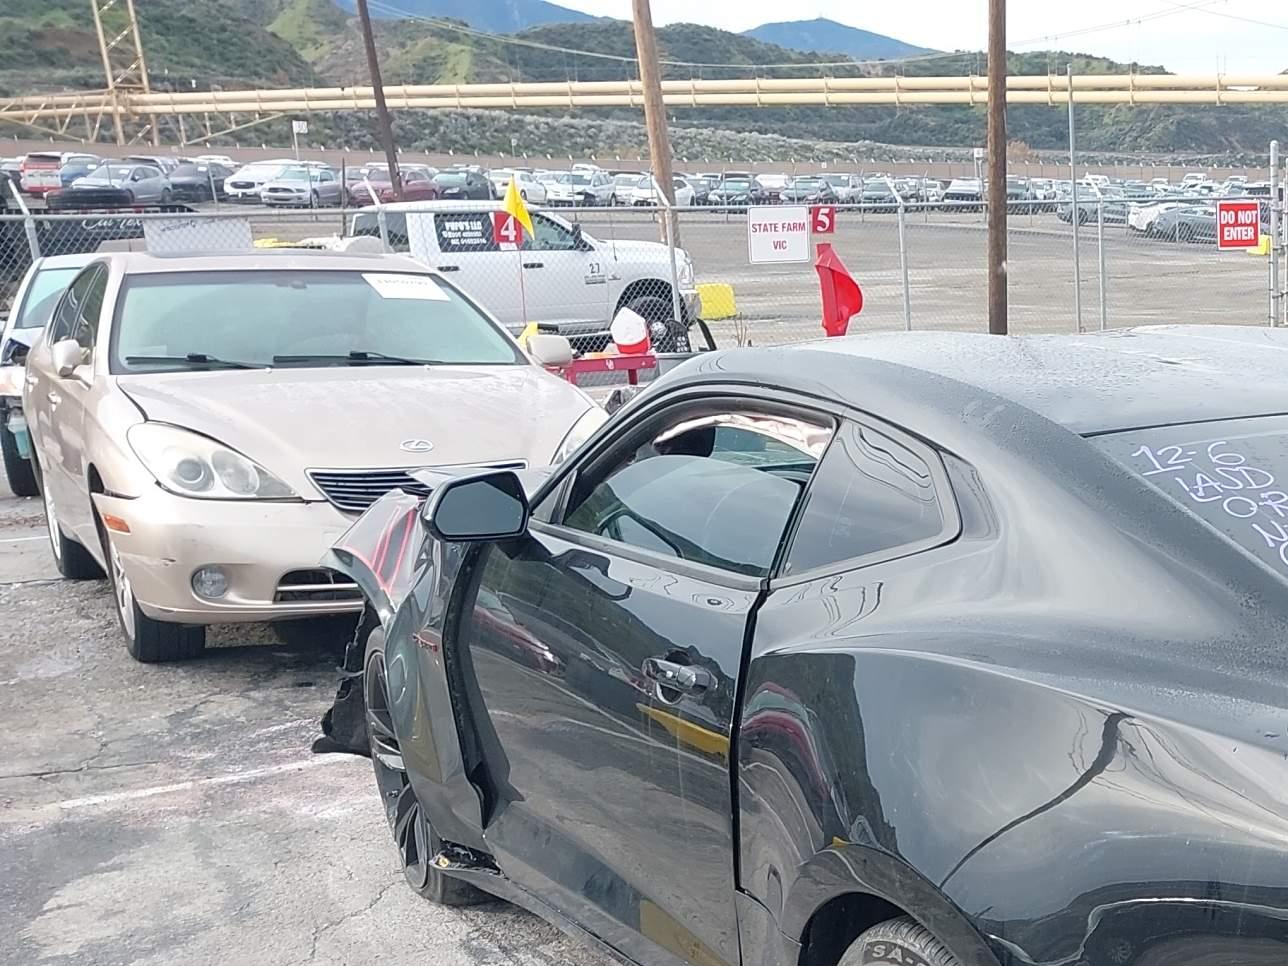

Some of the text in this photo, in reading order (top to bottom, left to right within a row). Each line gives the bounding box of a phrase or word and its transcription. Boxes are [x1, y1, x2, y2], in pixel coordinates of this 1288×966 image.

[816, 208, 830, 232] 5
[1221, 210, 1257, 224] DO NOT
[500, 215, 517, 241] 4
[752, 222, 806, 233] STATE FARM
[1224, 227, 1254, 240] ENTER
[773, 240, 787, 250] VIC
